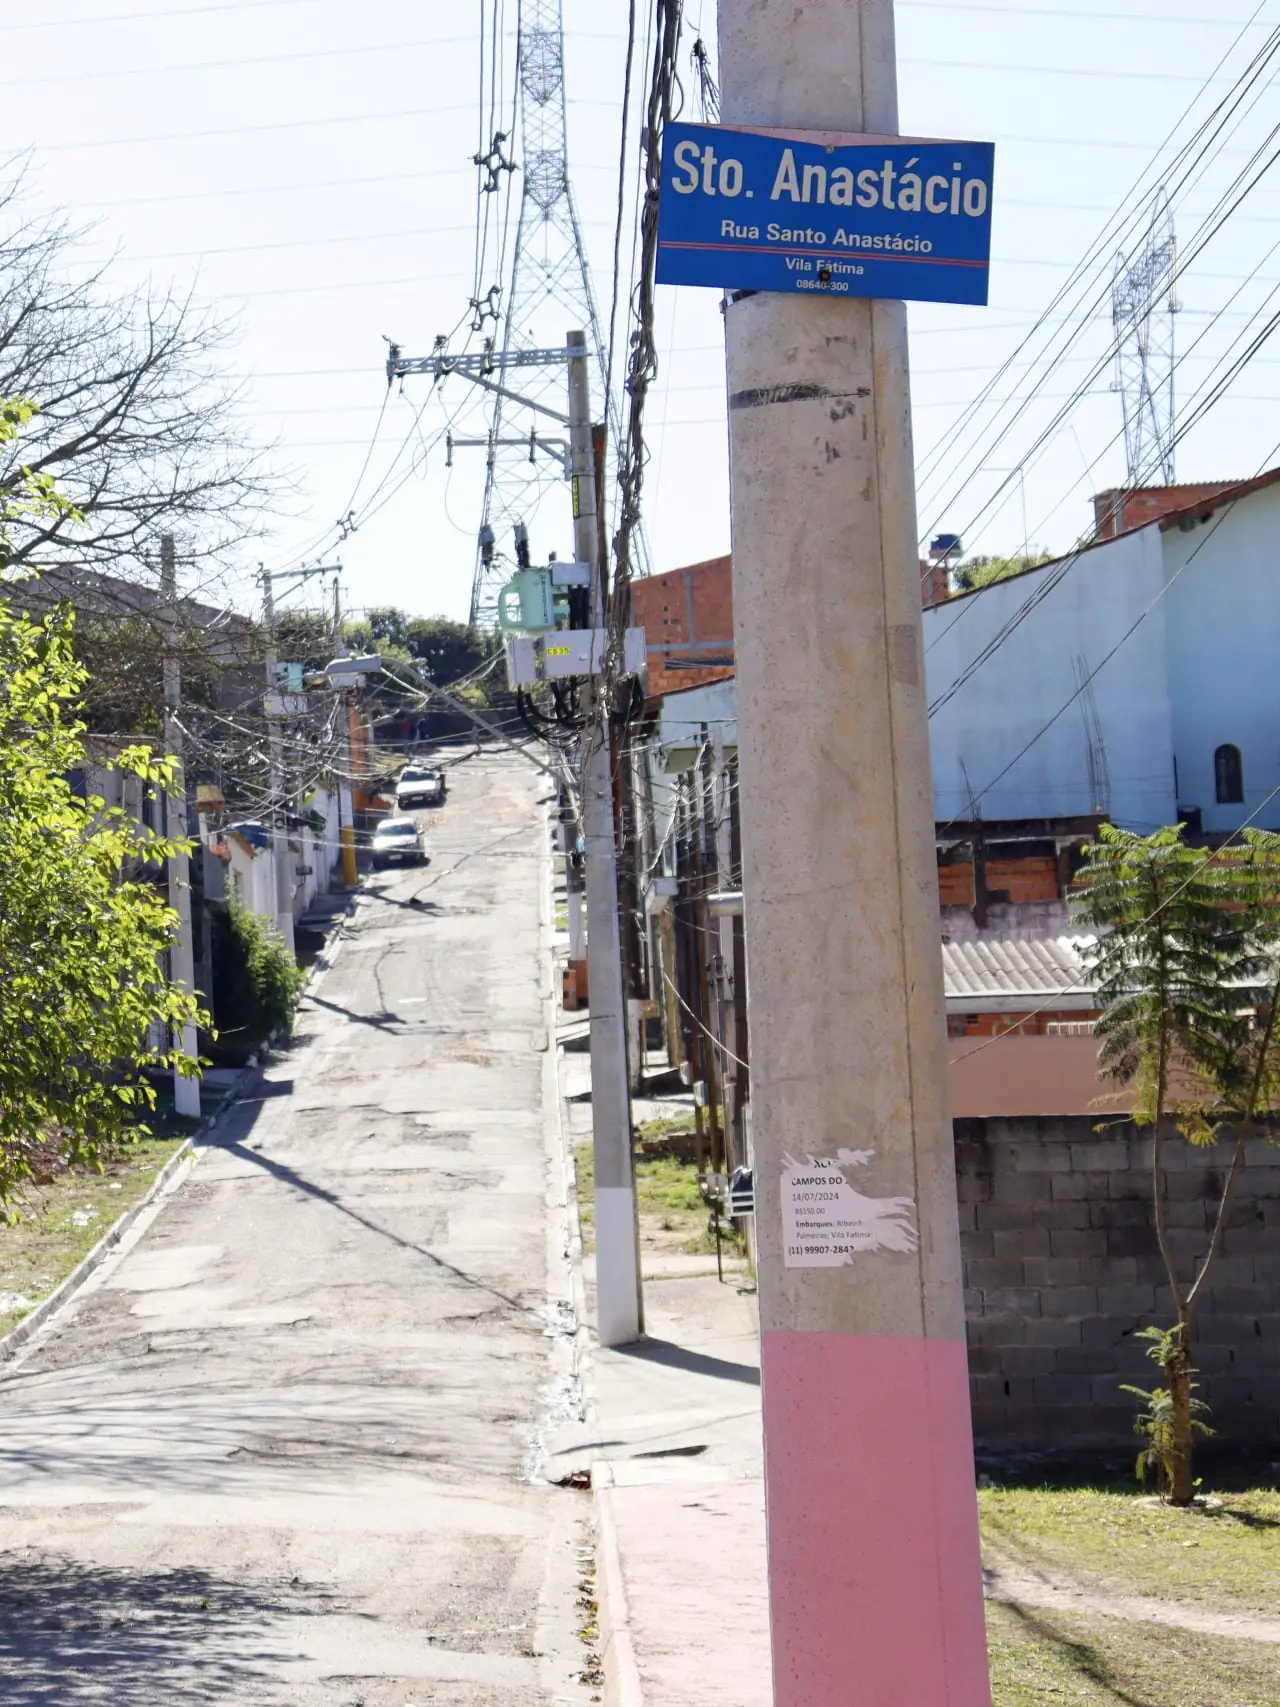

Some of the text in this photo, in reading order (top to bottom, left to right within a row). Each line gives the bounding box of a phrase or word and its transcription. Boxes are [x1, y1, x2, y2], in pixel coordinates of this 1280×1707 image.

[672, 140, 987, 217] Sto. Anastácio
[721, 219, 933, 253] Rua Santo Anastácio
[785, 257, 864, 275] Vila Fátima
[796, 278, 849, 292] 08640-300
[828, 1177, 843, 1185] DO
[792, 1192, 840, 1202] 14/07/2024
[788, 1246, 803, 1256] (11)
